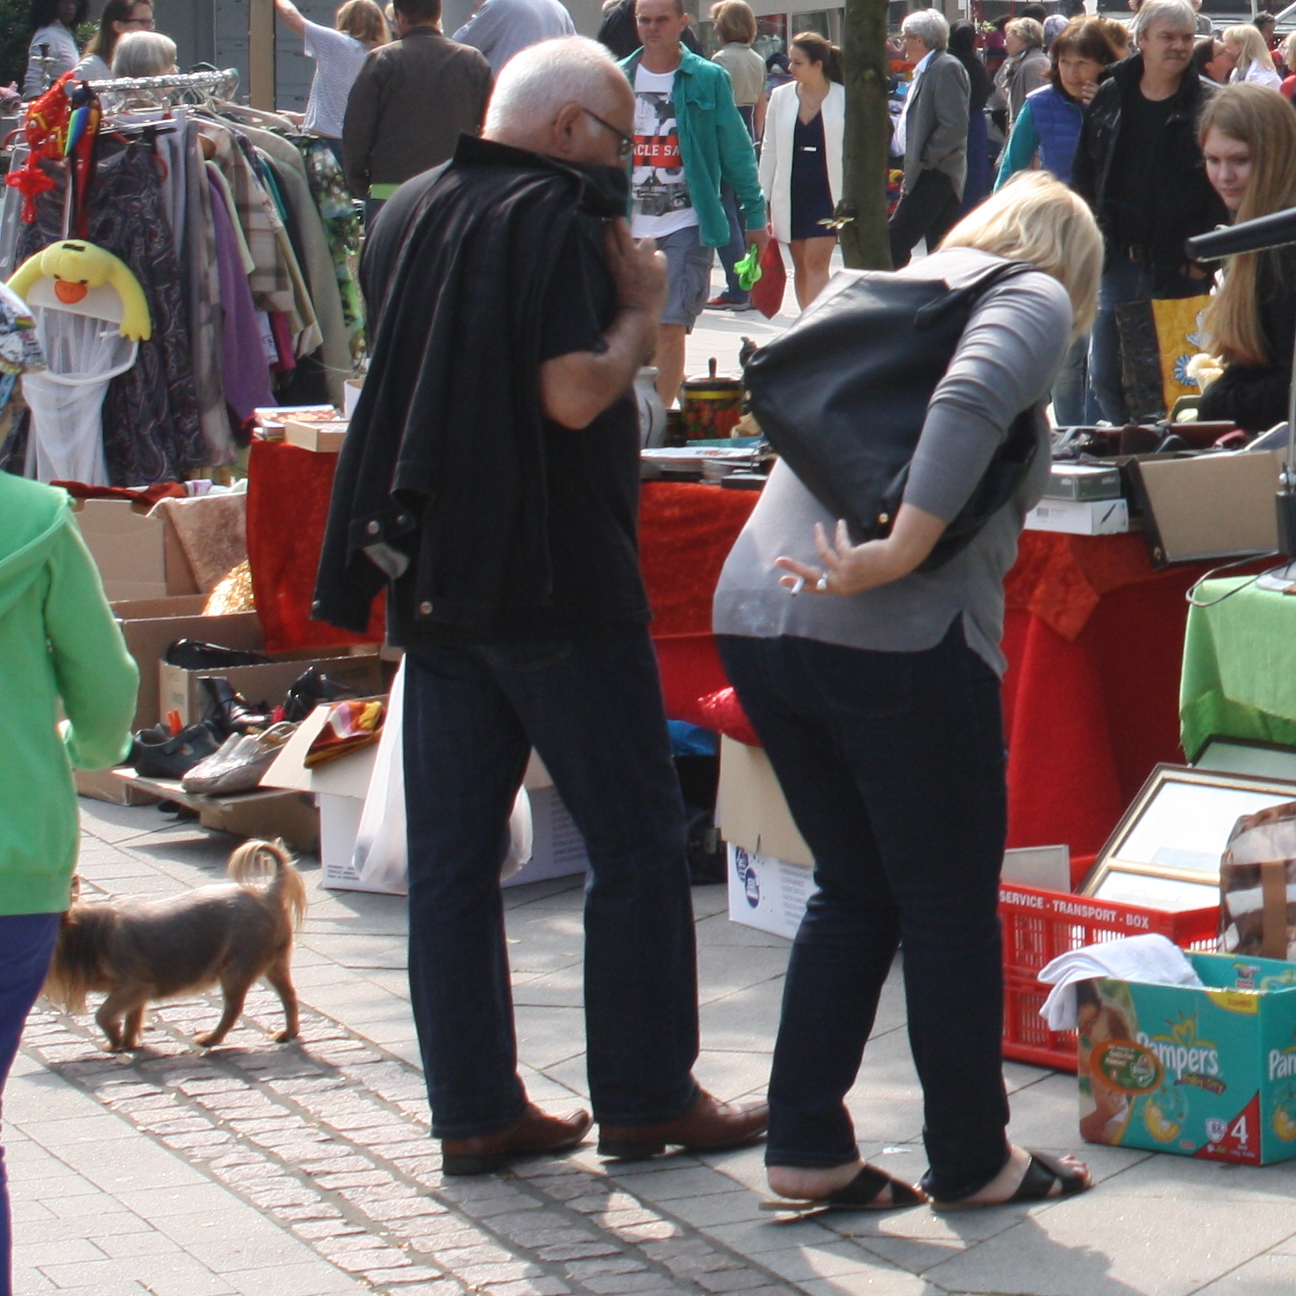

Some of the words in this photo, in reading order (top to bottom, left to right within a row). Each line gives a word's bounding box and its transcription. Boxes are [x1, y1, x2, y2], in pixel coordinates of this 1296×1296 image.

[1000, 890, 1044, 909] SERVICE
[1053, 900, 1117, 922] TRANSPORT
[1126, 914, 1149, 929] BOX
[1135, 1032, 1219, 1081] Pampers
[1231, 1115, 1249, 1144] 4
